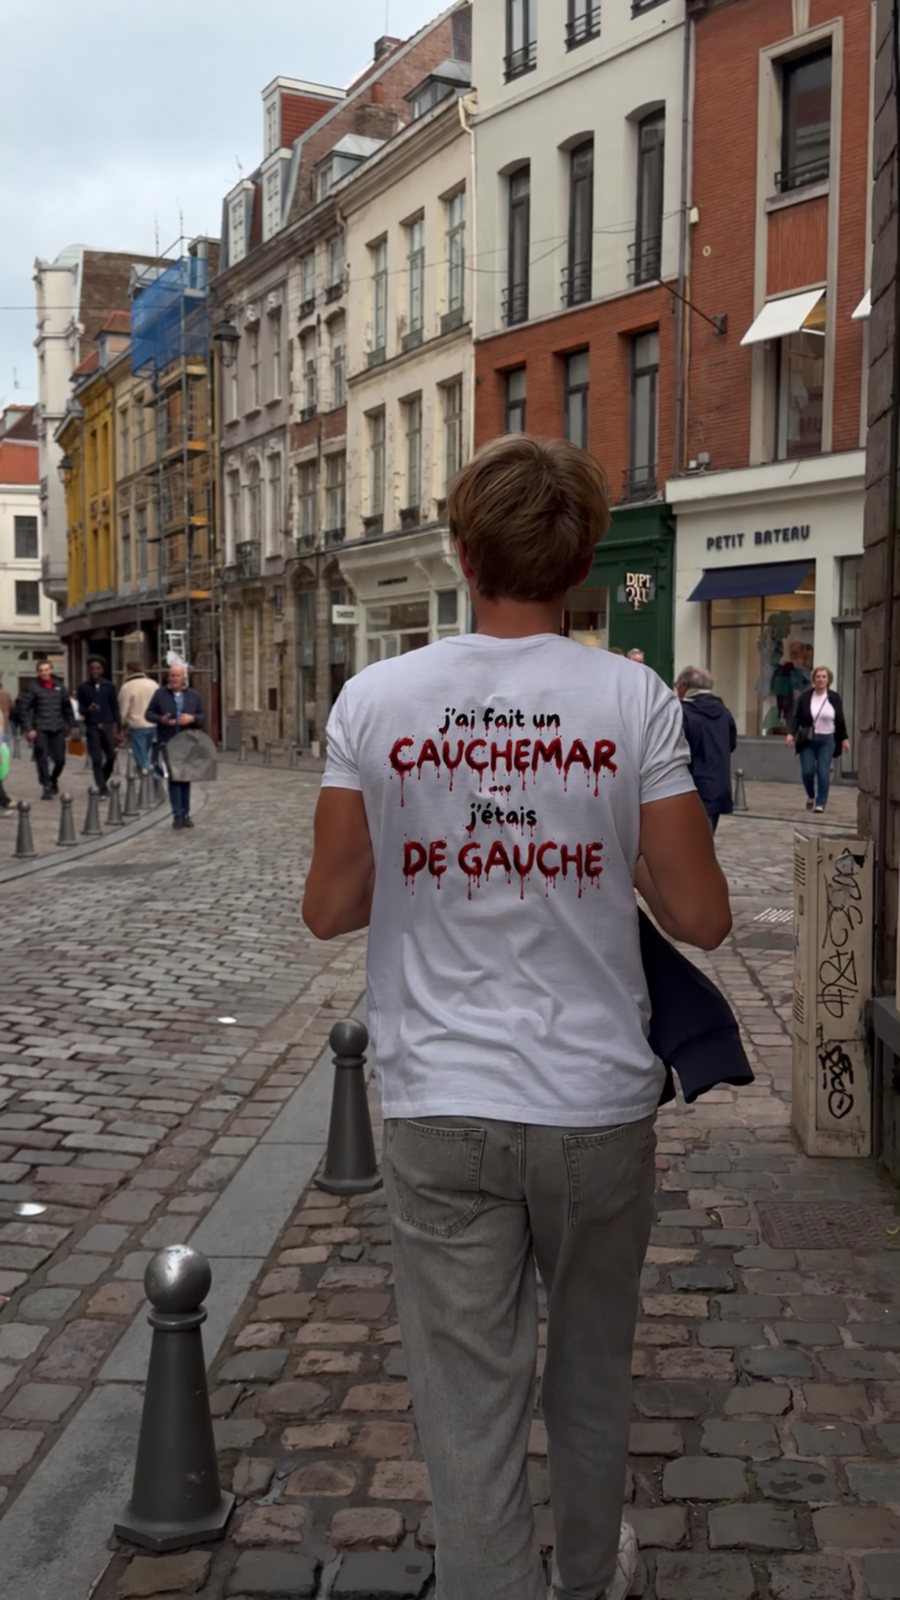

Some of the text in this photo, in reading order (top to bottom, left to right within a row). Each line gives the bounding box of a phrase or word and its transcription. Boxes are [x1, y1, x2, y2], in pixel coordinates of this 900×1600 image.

[706, 524, 810, 551] PETIT BATEAU
[439, 707, 560, 733] j'ai fait un
[389, 736, 618, 777] CAUCHEMAR
[466, 803, 537, 832] j'étais
[403, 840, 604, 880] DE GAUCHE
